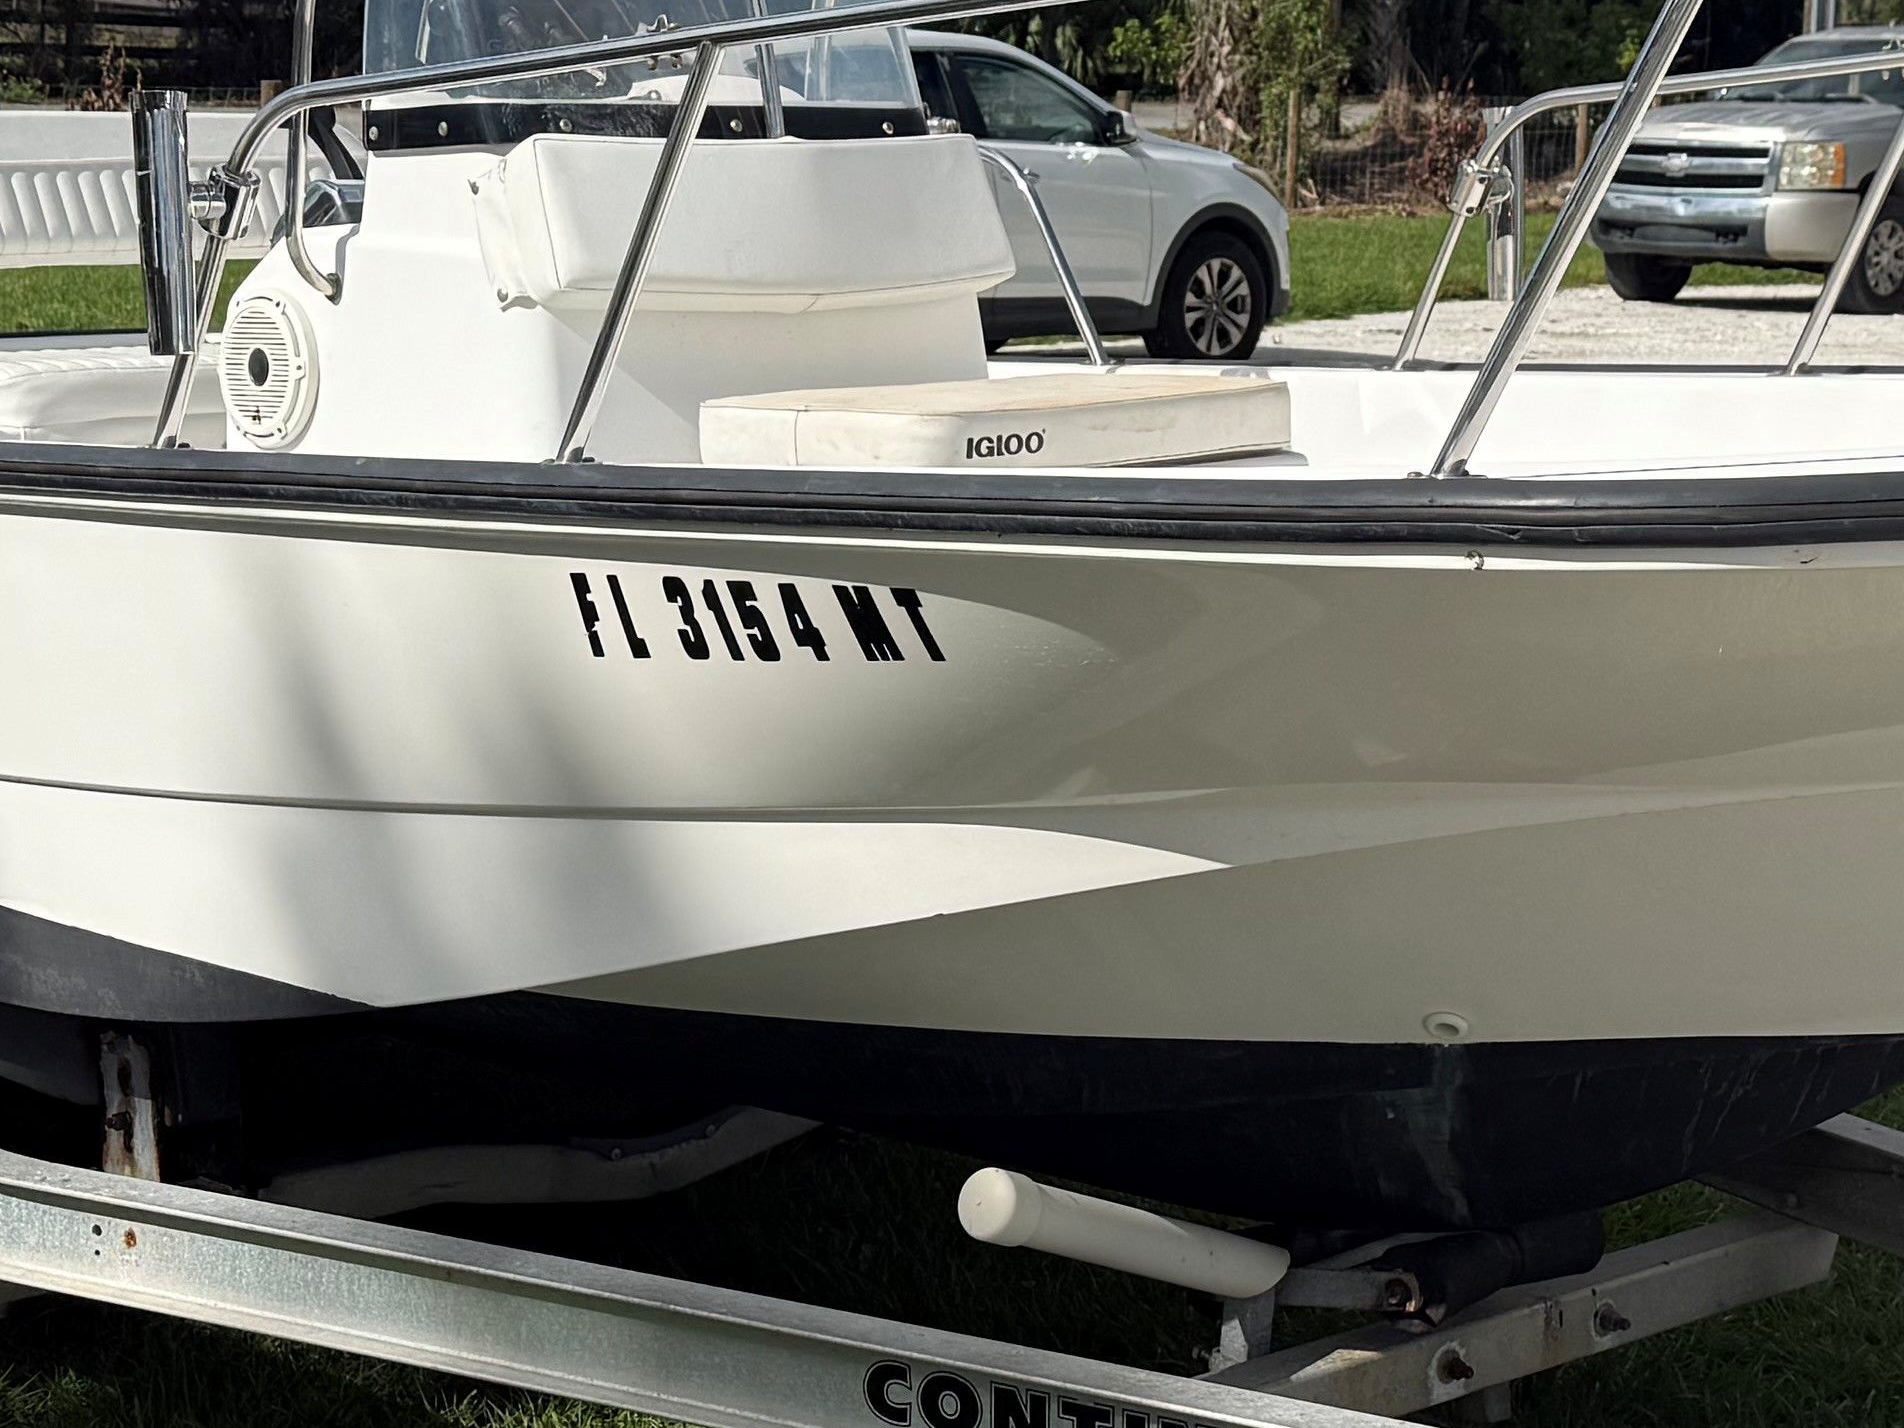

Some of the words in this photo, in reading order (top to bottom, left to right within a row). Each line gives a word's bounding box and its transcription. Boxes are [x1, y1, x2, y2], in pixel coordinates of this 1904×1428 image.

[965, 432, 1045, 459] IGLOO
[570, 572, 652, 659] FL
[662, 575, 831, 662] 3154
[832, 584, 947, 662] MT
